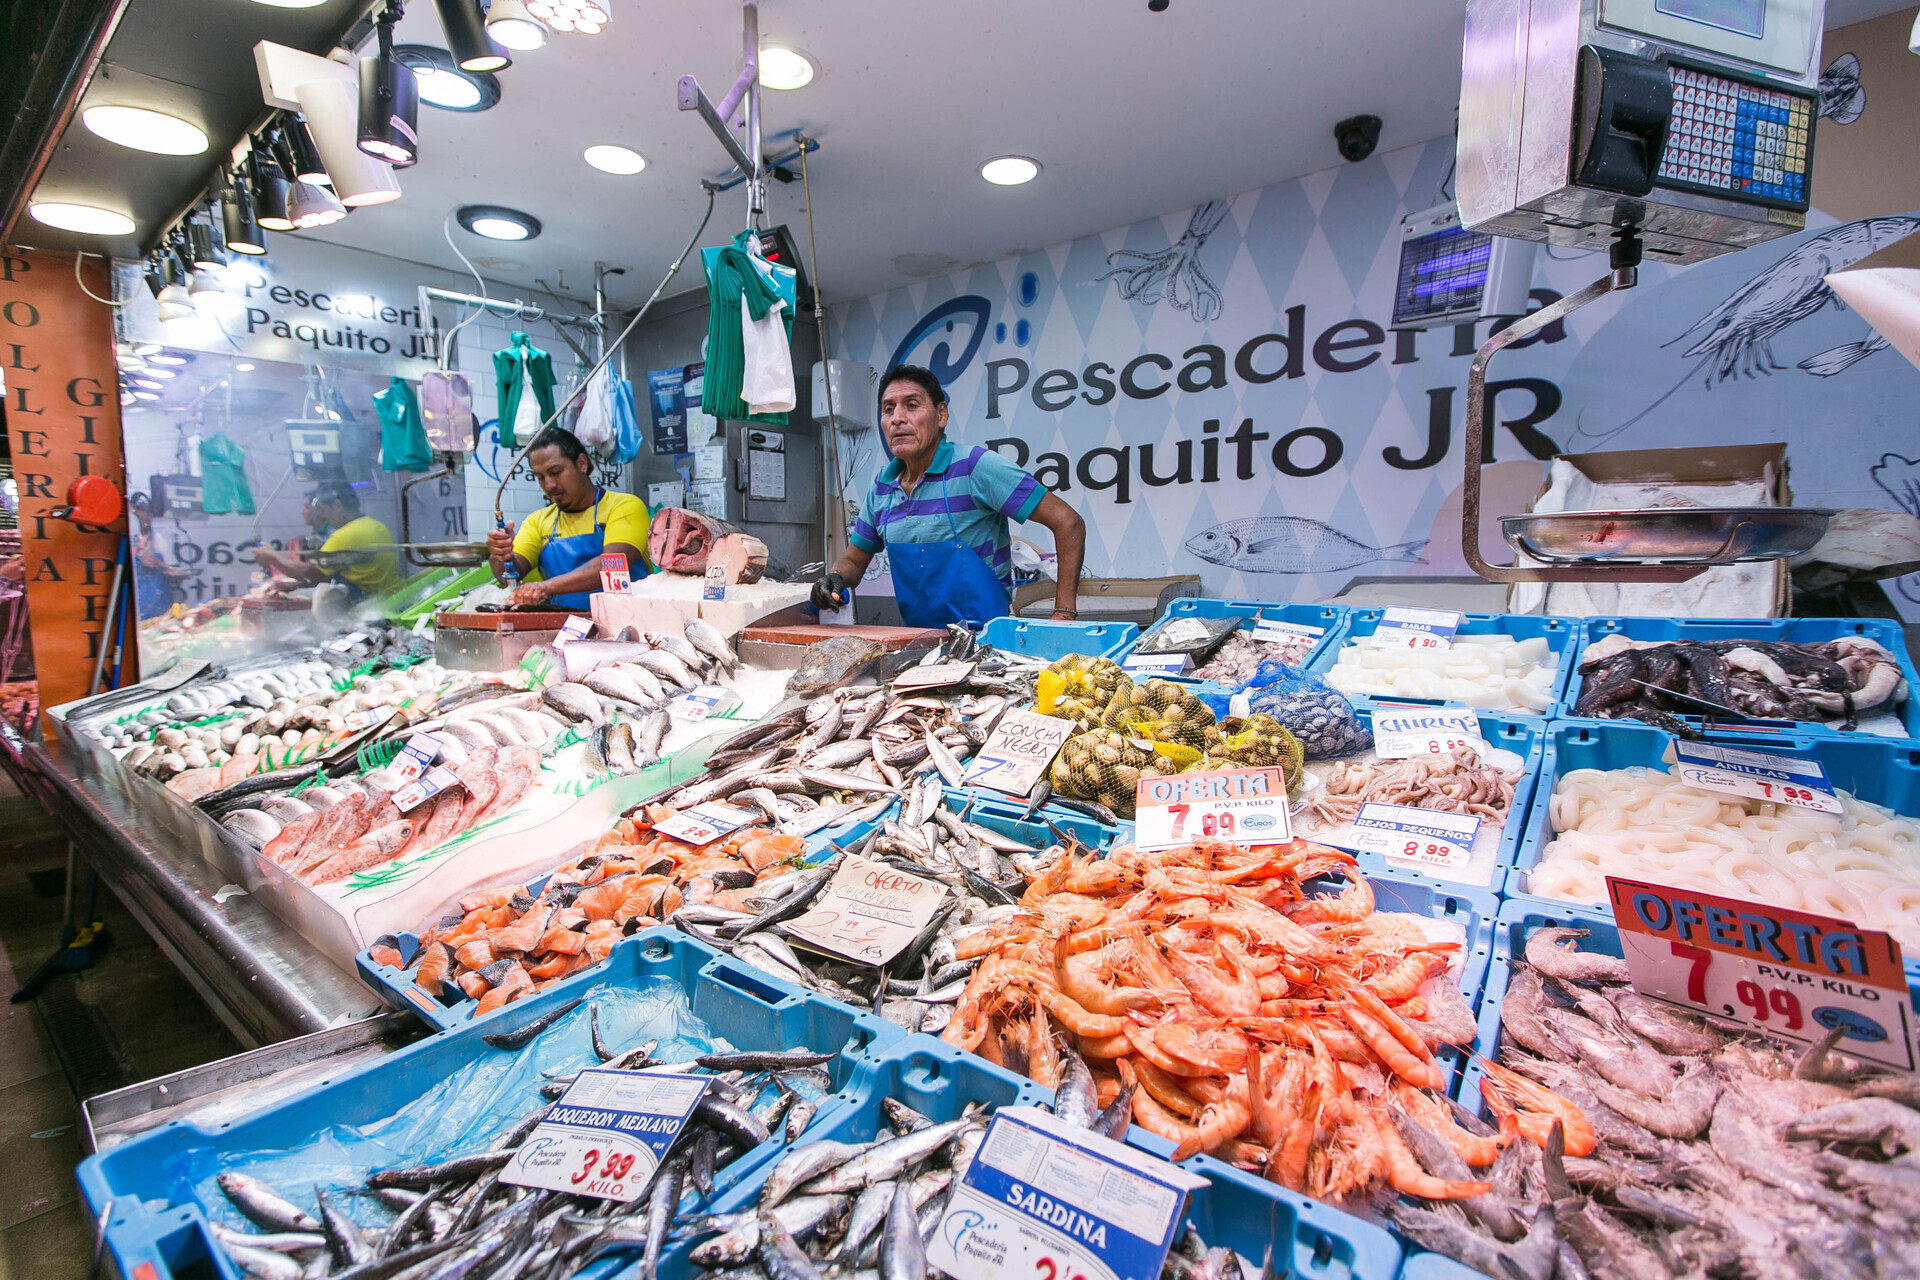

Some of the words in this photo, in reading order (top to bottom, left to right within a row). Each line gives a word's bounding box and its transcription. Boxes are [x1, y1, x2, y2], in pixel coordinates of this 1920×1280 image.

[246, 307, 391, 355] Paquito
[1382, 378, 1563, 470] JR
[1401, 623, 1431, 632] RABAS
[998, 736, 1048, 758] NEGRA
[999, 721, 1062, 747] CONCHA
[1715, 762, 1790, 779] ANILLAS
[1150, 773, 1269, 802] OFERTA
[1168, 803, 1190, 839] 7
[1356, 819, 1396, 830] REJOS
[865, 871, 922, 895] OFERTA
[1632, 893, 1870, 977] OFERTA
[1757, 965, 1815, 987] P.V.P.
[1822, 979, 1880, 1001] KILO
[546, 1107, 615, 1129] BOQUERON
[615, 1114, 680, 1135] MEDIANO
[1007, 1184, 1107, 1249] SARDINA
